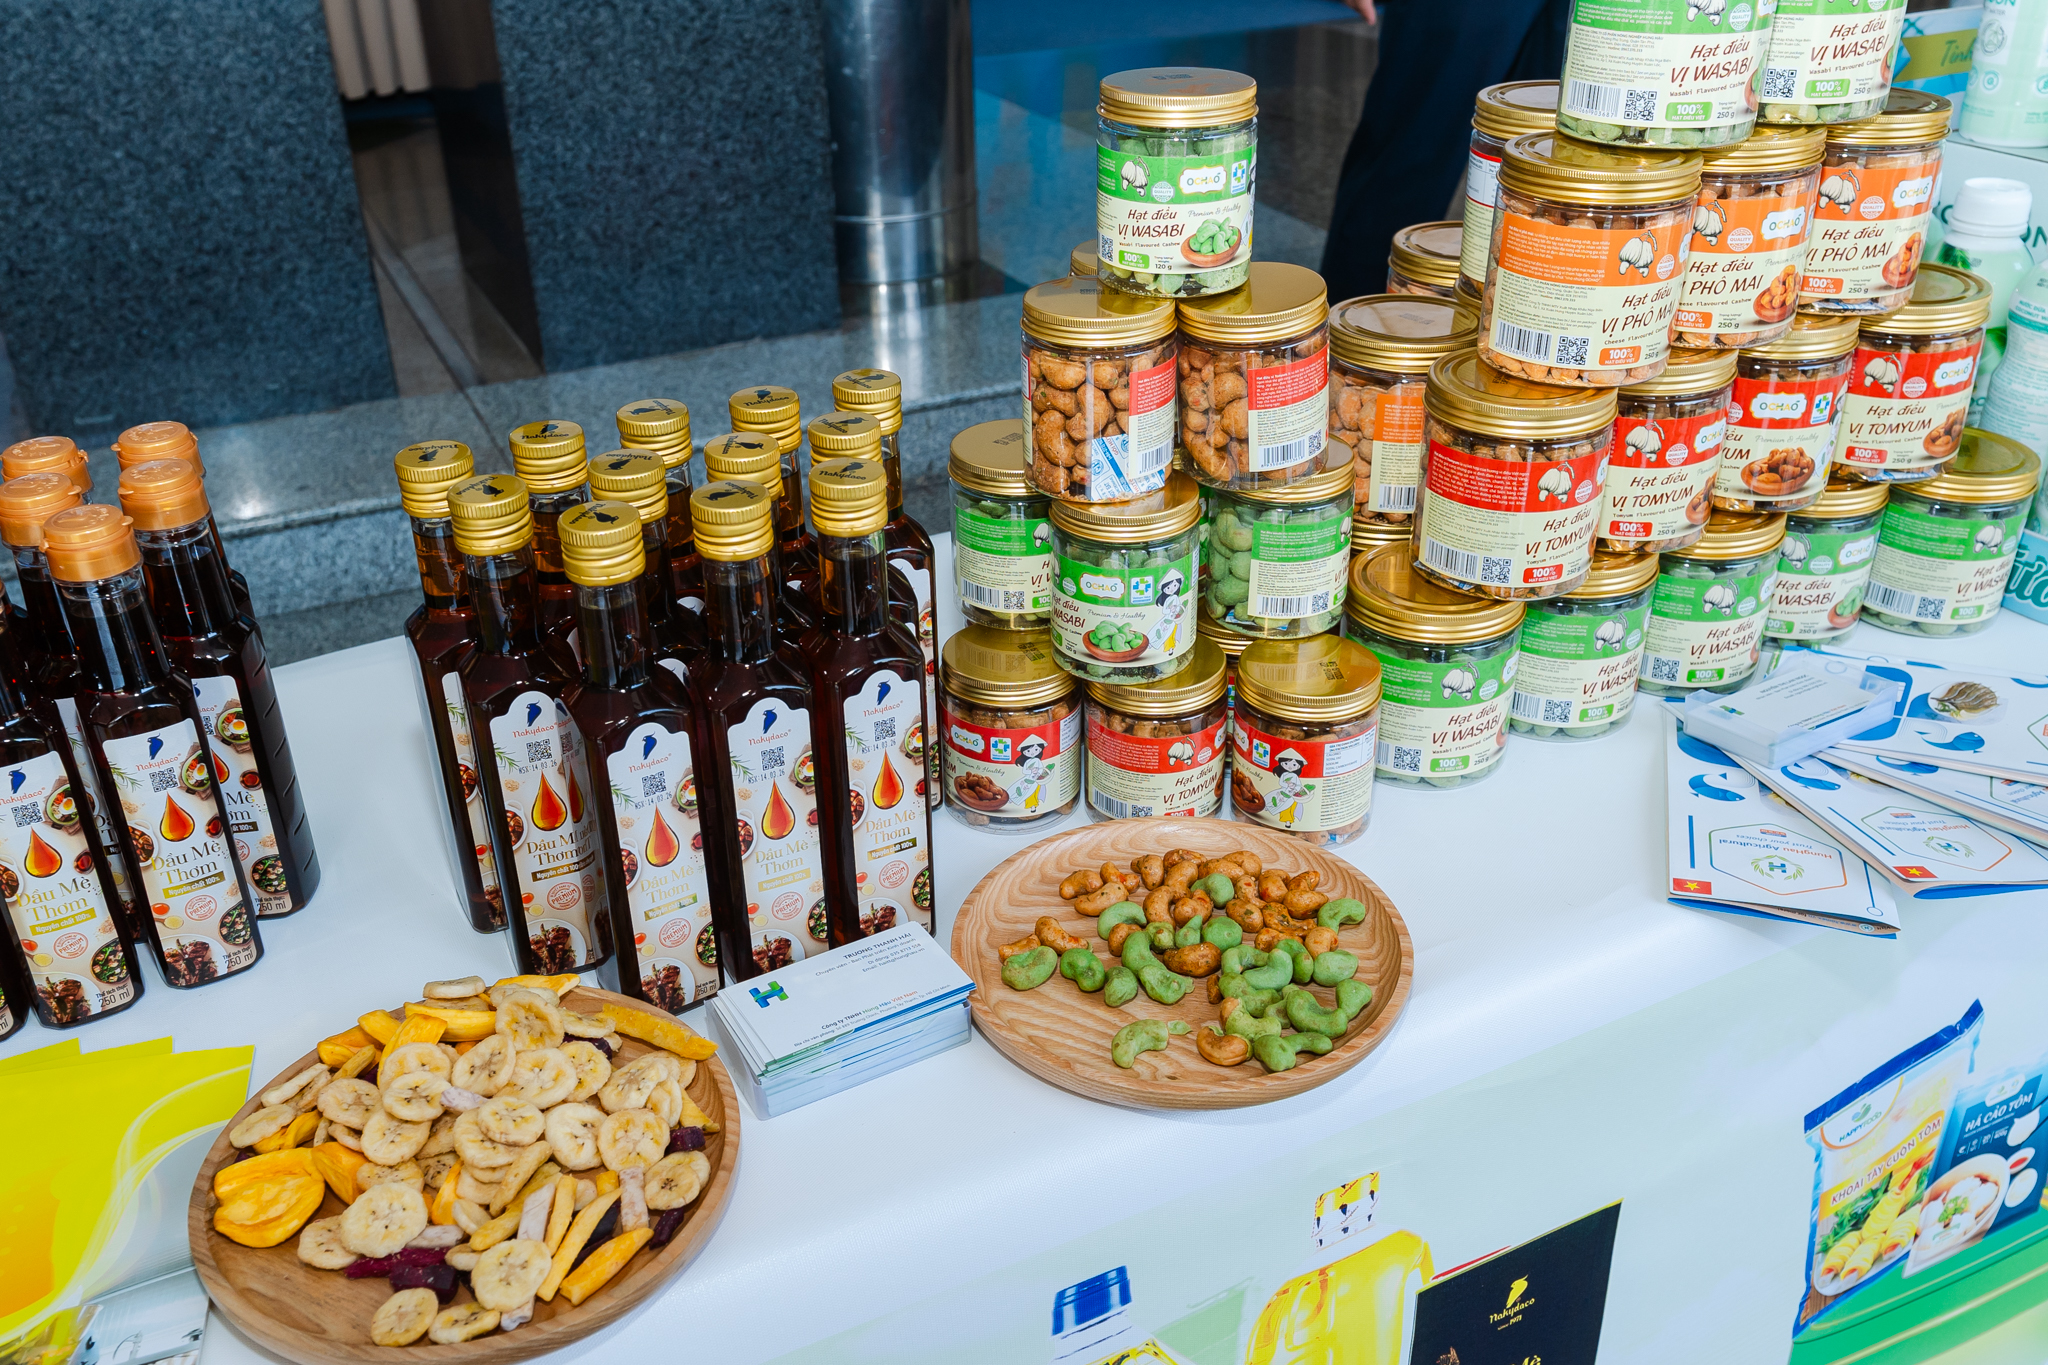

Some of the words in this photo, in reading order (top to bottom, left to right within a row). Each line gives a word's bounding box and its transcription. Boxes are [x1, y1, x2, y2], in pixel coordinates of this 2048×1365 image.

[1690, 44, 1720, 62] Hạt
[1811, 45, 1829, 66] VỊ
[1833, 34, 1889, 60] WASABI
[1671, 66, 1690, 88] VỊ
[1694, 57, 1753, 82] WASABI
[1809, 67, 1831, 75] Wasabi
[1835, 62, 1865, 72] Flavoured
[1867, 58, 1881, 66] Cashew
[1670, 89, 1693, 97] Wasabi
[1697, 84, 1727, 94] Flavoured
[1816, 82, 1842, 91] 100%
[1677, 104, 1704, 115] 100%
[1127, 209, 1147, 222] Hạt
[1118, 223, 1129, 240] VỊ
[1132, 224, 1185, 238] WASABI
[1822, 228, 1851, 243] Hạt
[1124, 253, 1142, 263] 100%
[1689, 261, 1718, 277] Hạt
[1689, 276, 1726, 295] PHÔ
[1730, 275, 1763, 293] MAI
[1809, 278, 1834, 288] 100%
[1622, 295, 1648, 313] Hạt
[1602, 317, 1617, 338] VỊ
[1622, 309, 1654, 331] PHÔ
[1657, 300, 1675, 321] MAI
[1628, 331, 1654, 342] Flavoured
[1609, 348, 1633, 359] 100%
[1866, 405, 1896, 419] Hạt
[1849, 423, 1863, 438] VỊ
[1869, 418, 1933, 435] TOMYUM
[1854, 448, 1878, 458] 100%
[819, 470, 867, 480] Nakydaco
[1630, 476, 1658, 490] Hạt
[1612, 496, 1627, 512] VỊ
[1632, 485, 1694, 508] TOMYUM
[1543, 517, 1567, 535] Hạt
[1619, 522, 1644, 532] 100%
[1526, 542, 1539, 558] VỊ
[1546, 518, 1594, 552] TOMYUM
[1533, 566, 1556, 577] 100%
[1778, 592, 1836, 606] WASABI
[1053, 608, 1086, 628] WASABI
[1690, 644, 1704, 659] VỊ
[1709, 630, 1757, 655] WASABI
[1448, 712, 1472, 727] Hạt
[1432, 731, 1448, 748] VỊ
[1451, 713, 1502, 743] WASABI
[1439, 757, 1463, 767] 100%
[1163, 794, 1175, 806] VỊ
[1178, 772, 1218, 801] TOMYUM
[1175, 775, 1194, 788] Hạt
[225, 791, 255, 806] Mè
[894, 809, 916, 827] Mè
[870, 826, 911, 846] Thơm
[191, 840, 221, 861] Mè
[786, 839, 809, 856] Mè
[1719, 839, 1779, 851] Agricultural
[1783, 847, 1832, 859] HungHau
[159, 861, 218, 885] Thơm
[671, 865, 694, 882] Mè
[761, 855, 804, 876] Thơm
[882, 866, 906, 884] PREMIUM
[58, 876, 91, 897] Mè
[646, 882, 690, 904] Thơm
[551, 889, 577, 905] PREMIUM
[26, 897, 88, 922] Thơm
[189, 900, 214, 917] PREMIUM
[257, 903, 273, 912] 250
[275, 901, 286, 910] ml
[775, 897, 800, 915] PREMIUM
[663, 924, 687, 943] PREMIUM
[58, 937, 84, 954] PREMIUM
[874, 938, 898, 948] THANH
[224, 957, 242, 969] 250
[244, 950, 254, 962] ml
[99, 995, 117, 1008] 250
[119, 988, 130, 1001] ml
[844, 1011, 862, 1022] TNHH
[903, 990, 918, 999] Nam
[1965, 1114, 1983, 1132] HÁ
[1983, 1105, 2007, 1124] CẢO
[2008, 1093, 2033, 1112] TÔM
[1838, 1110, 1883, 1143] HAPPYFOOD
[1830, 1177, 1865, 1207] KHOAI
[1866, 1162, 1885, 1184] TÂY
[1886, 1139, 1917, 1171] CUỘN
[1918, 1118, 1942, 1142] TÔM
[1489, 1298, 1535, 1324] Nakydaco
[1509, 1314, 1523, 1326] 1971
